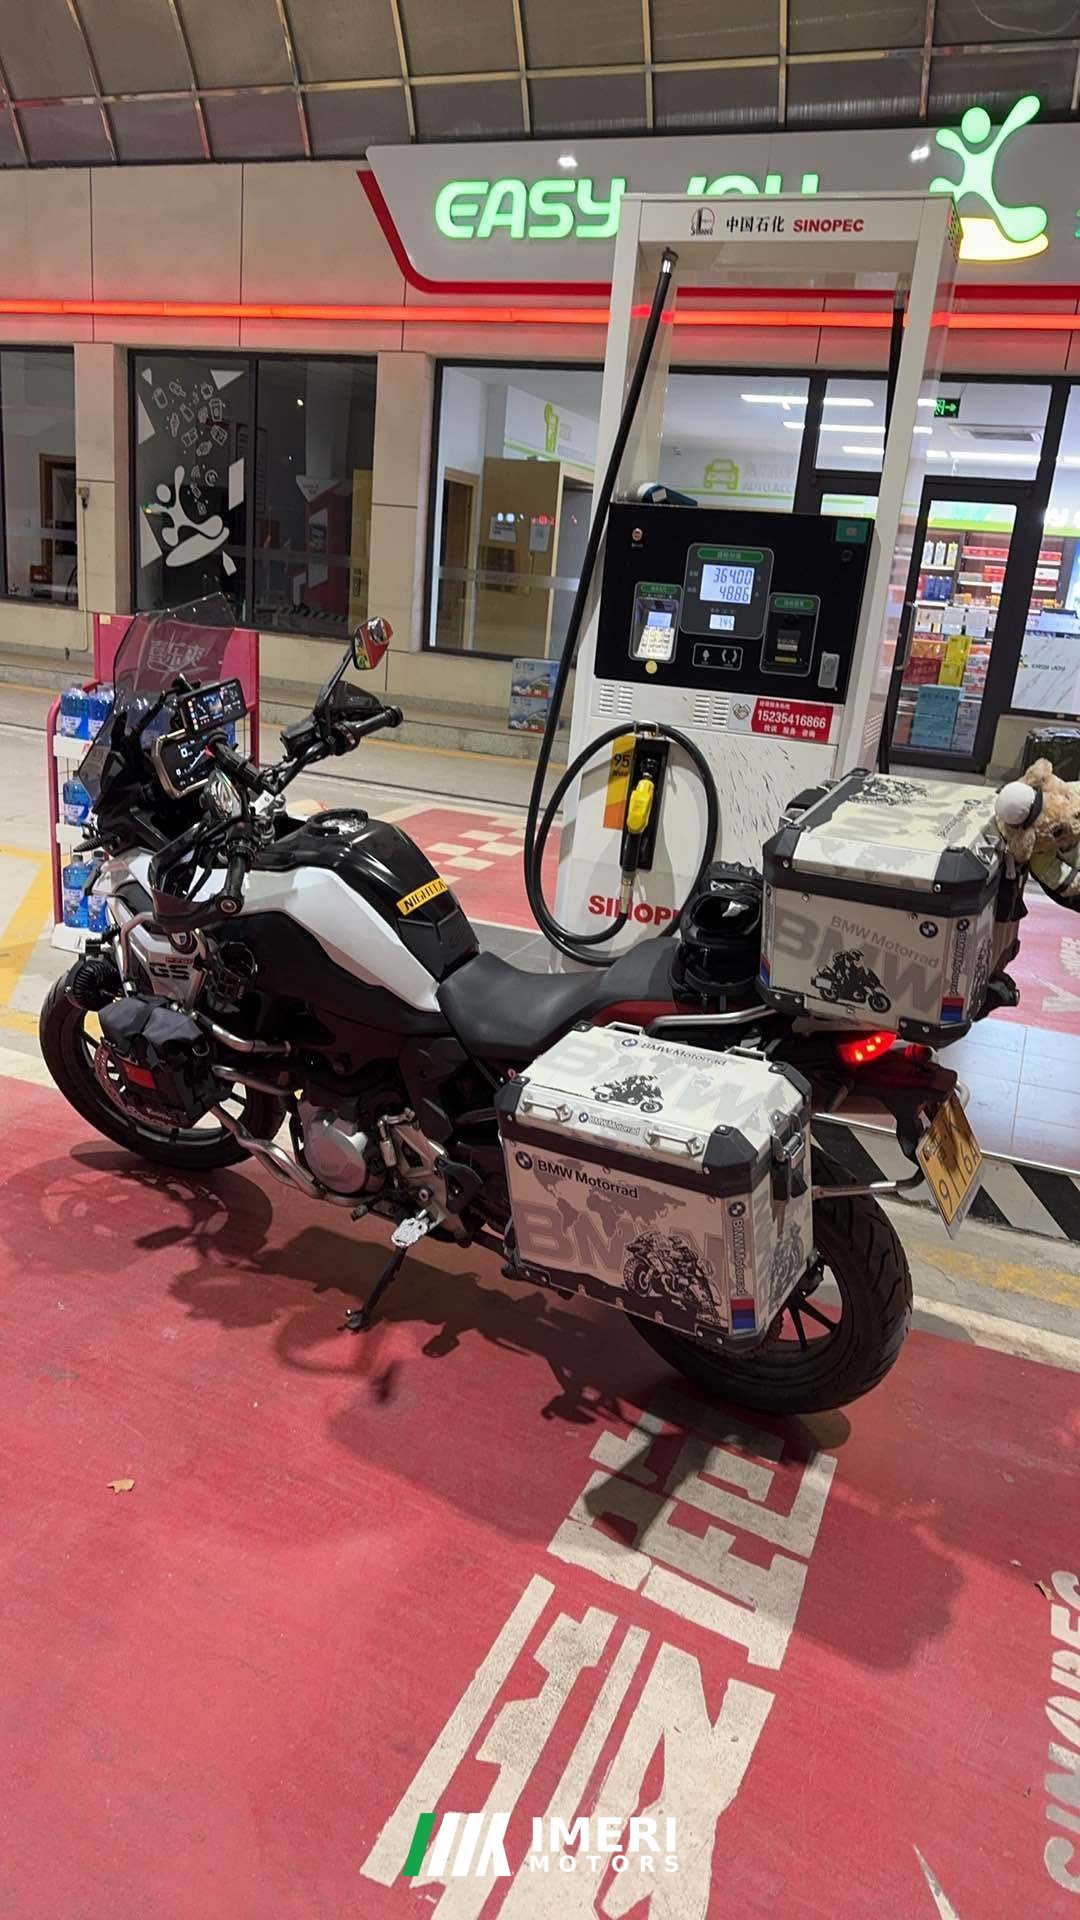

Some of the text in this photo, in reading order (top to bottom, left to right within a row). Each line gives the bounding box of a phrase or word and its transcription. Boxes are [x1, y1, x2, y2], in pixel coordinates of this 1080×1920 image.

[435, 177, 626, 239] EASY
[725, 214, 785, 233] 中国石化
[793, 218, 865, 234] SINOPEC
[756, 709, 827, 729] 15235416866
[613, 753, 631, 768] 95
[588, 894, 681, 926] SIOP
[831, 915, 940, 969] BMW Motorrad
[148, 962, 190, 981] GS
[640, 1042, 728, 1066] BMW Motorrad
[537, 1158, 639, 1199] BMW Motorrad
